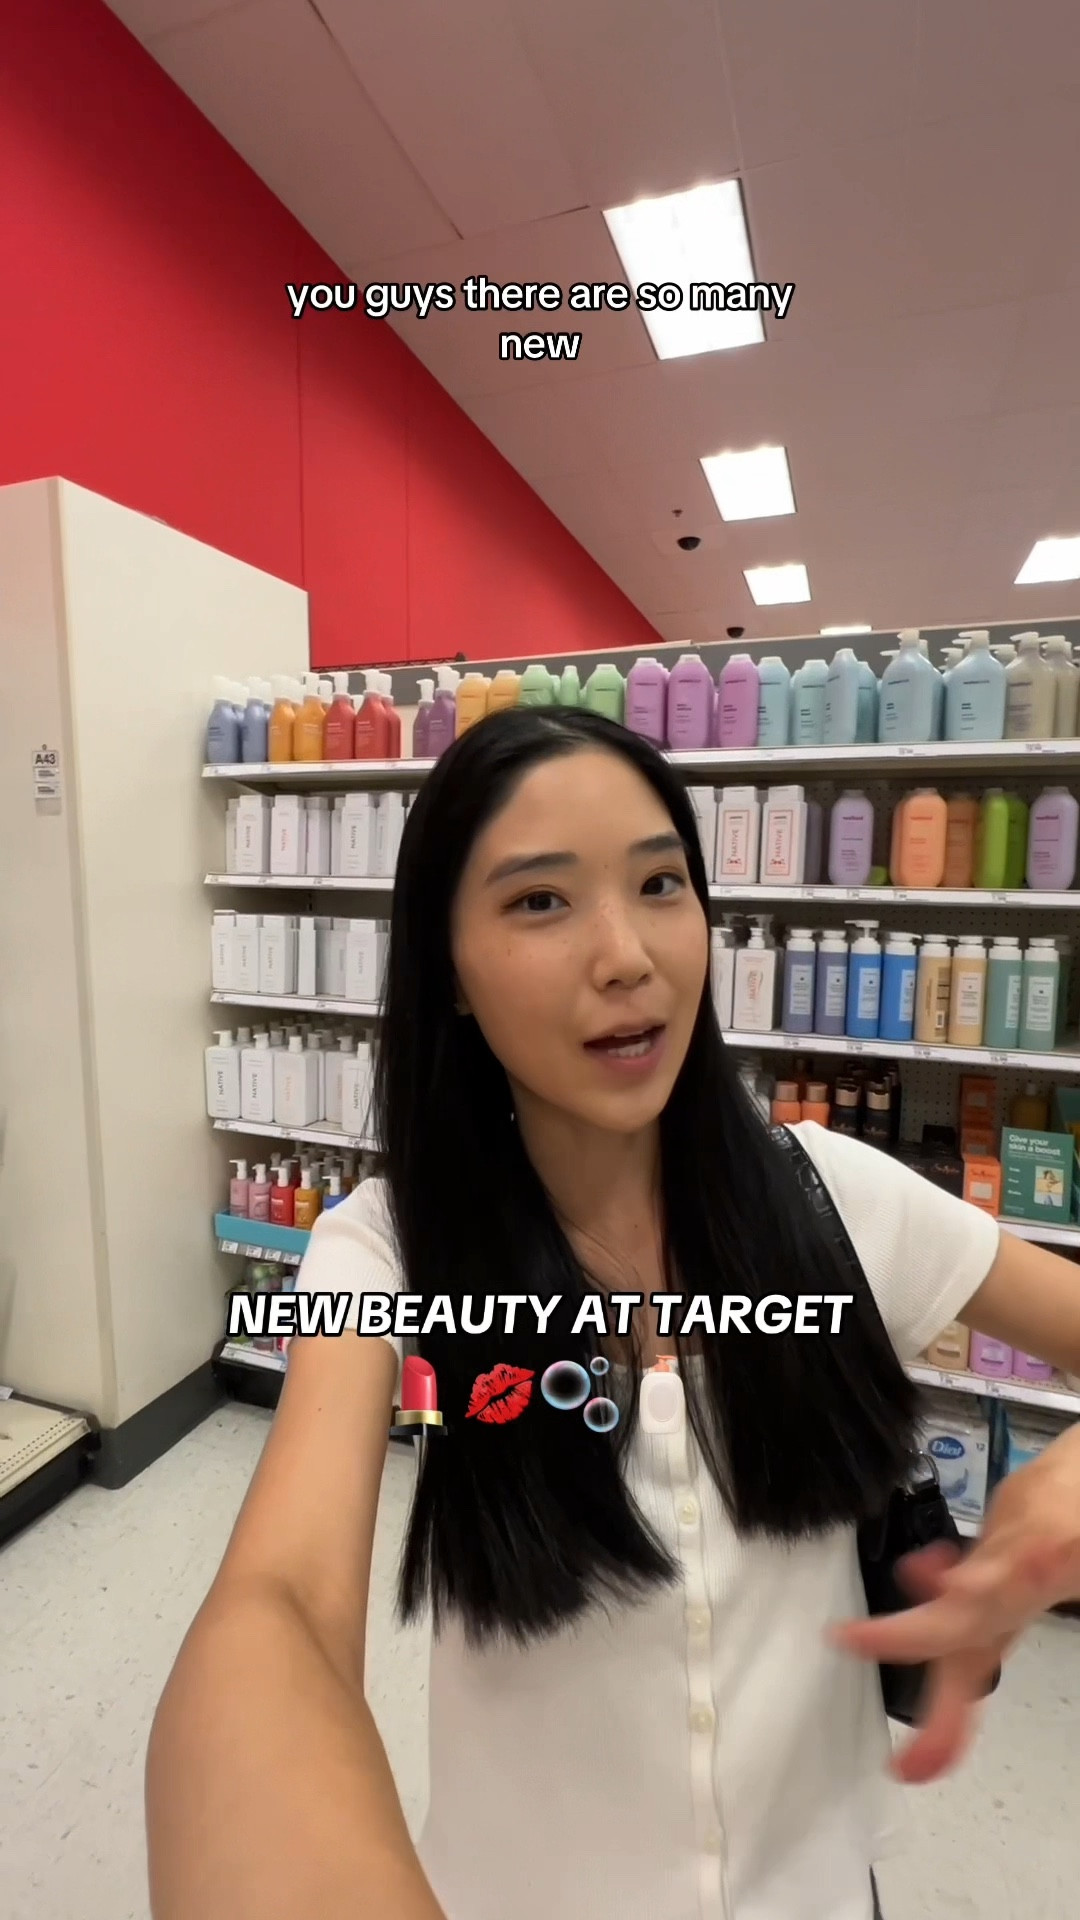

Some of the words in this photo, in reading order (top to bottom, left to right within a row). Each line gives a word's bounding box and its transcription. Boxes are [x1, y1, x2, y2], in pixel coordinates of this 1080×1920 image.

[35, 753, 56, 765] A43
[1008, 1134, 1028, 1143] Give
[1029, 1138, 1049, 1146] your
[1008, 1142, 1027, 1151] skin
[1034, 1147, 1061, 1156] boost
[931, 1440, 962, 1456] Dial
